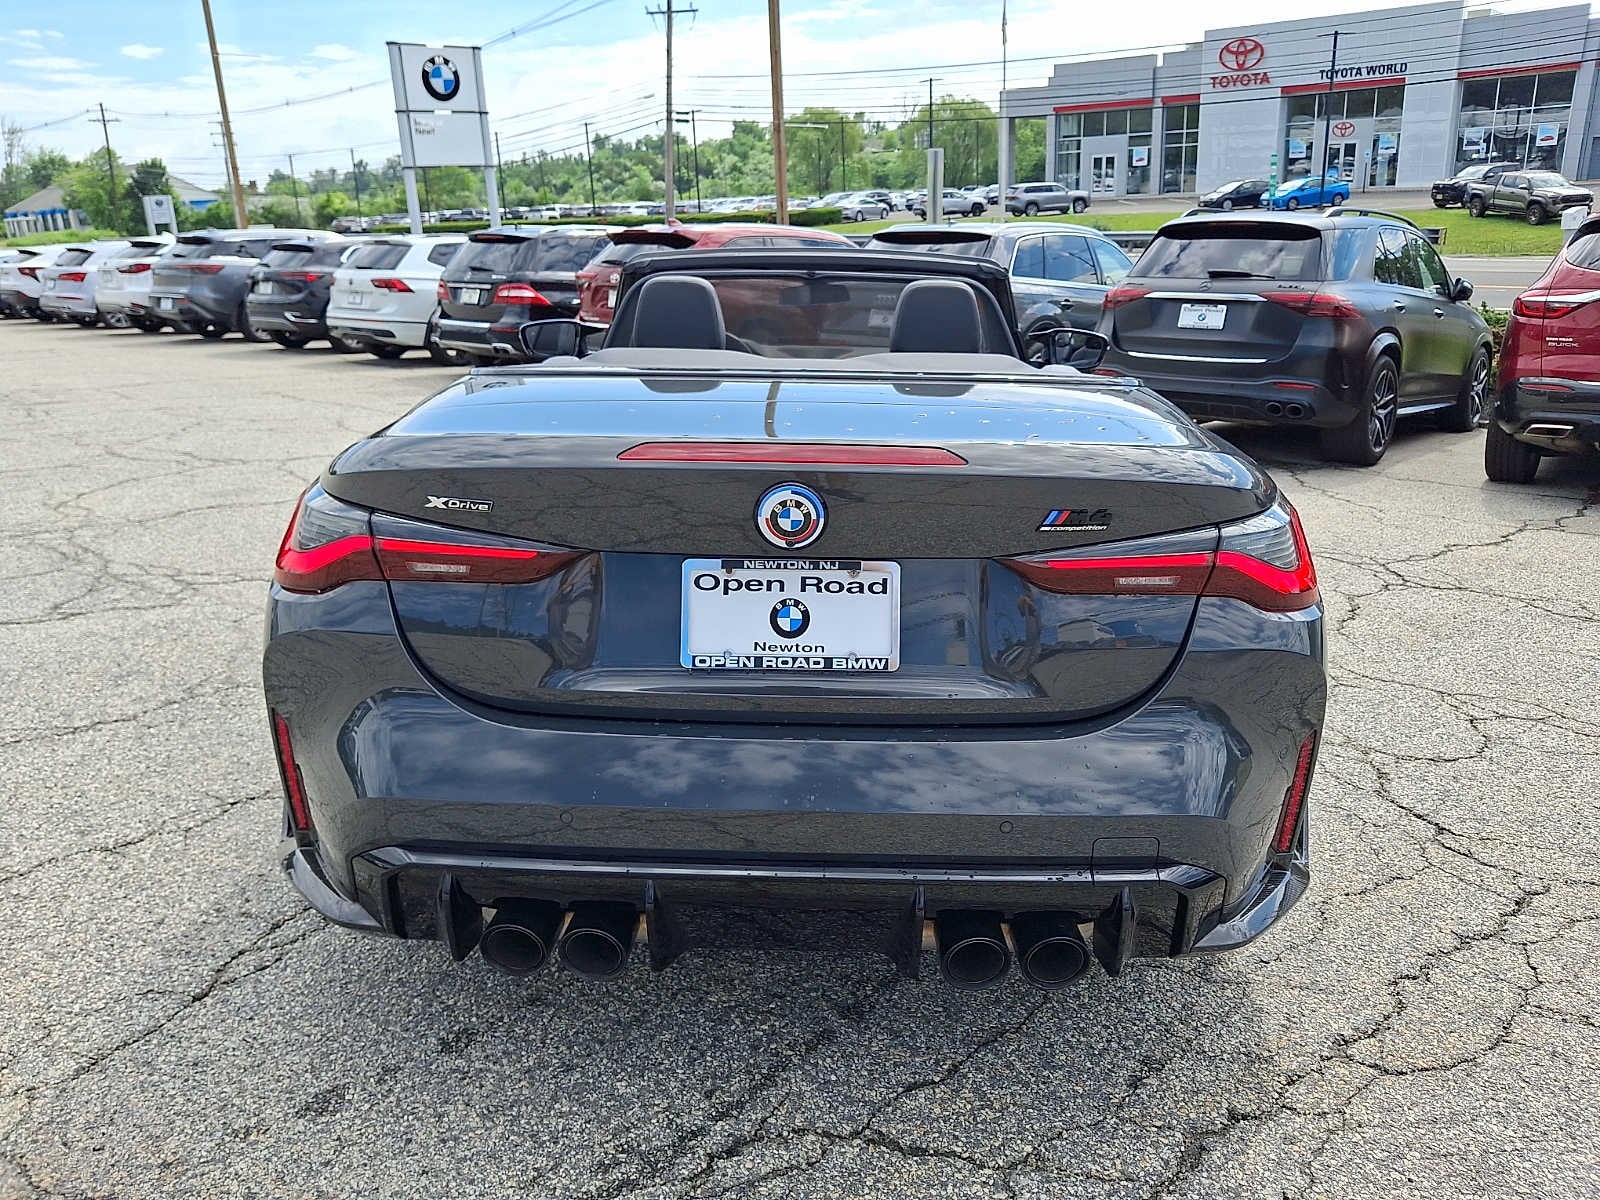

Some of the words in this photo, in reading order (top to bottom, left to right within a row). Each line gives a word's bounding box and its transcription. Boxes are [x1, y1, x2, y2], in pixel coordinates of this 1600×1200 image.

[1320, 66, 1362, 80] TOYOTA
[1366, 62, 1408, 77] WORLD
[1210, 72, 1271, 88] TOYOTA
[773, 499, 810, 514] BMW
[819, 561, 839, 570] NJ
[693, 573, 785, 595] Open
[800, 577, 888, 595] Road
[775, 599, 807, 611] BMW
[753, 641, 825, 653] Newton
[694, 656, 756, 669] OPEN
[762, 657, 825, 670] ROAD
[832, 658, 887, 670] BMW
